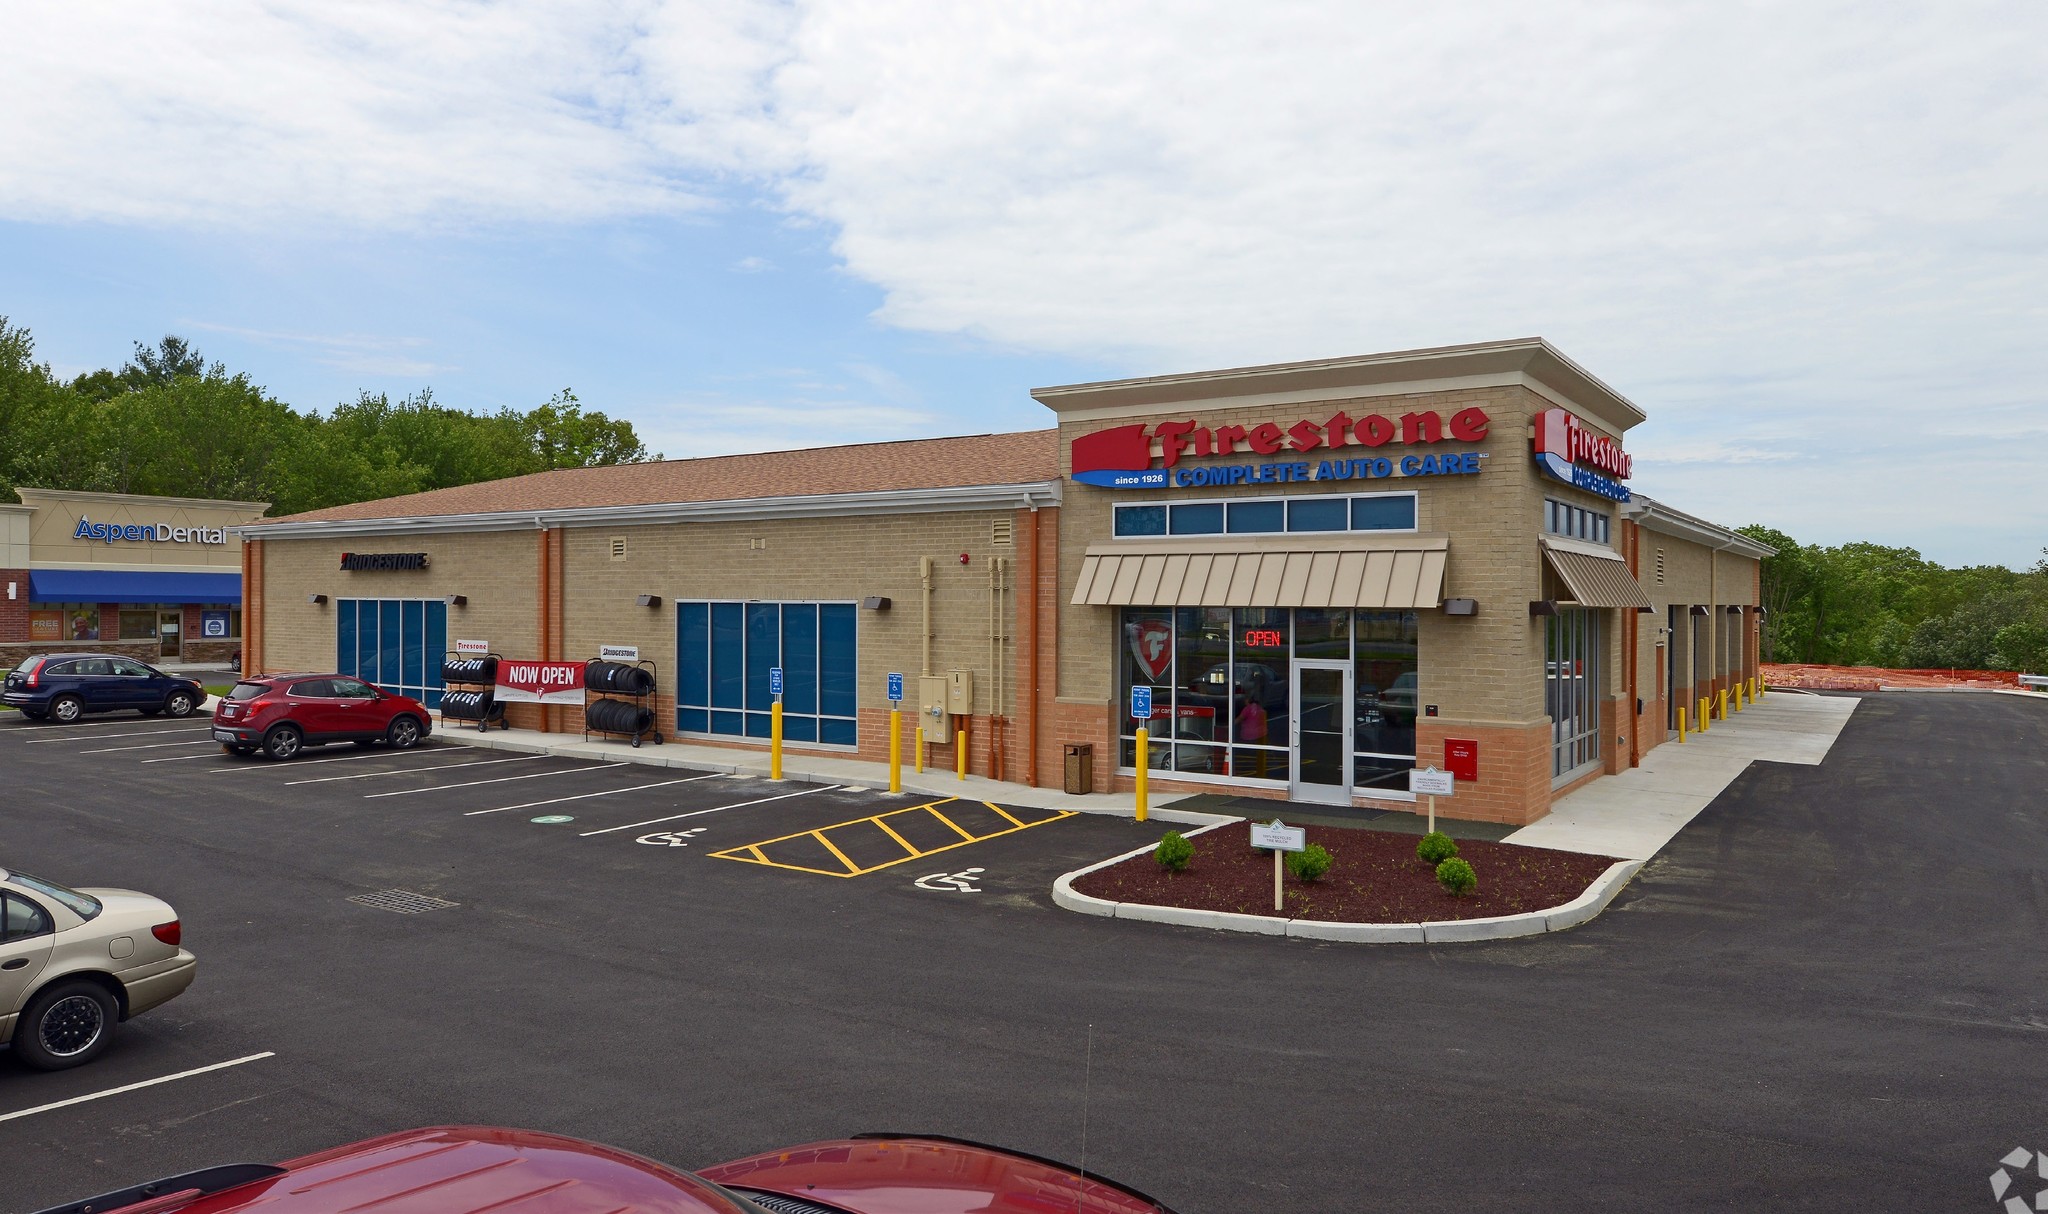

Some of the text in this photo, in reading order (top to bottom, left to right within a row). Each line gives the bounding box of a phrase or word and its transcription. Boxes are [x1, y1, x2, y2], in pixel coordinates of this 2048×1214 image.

[1154, 407, 1490, 468] Firestone
[1568, 414, 1632, 479] Firestone
[1175, 462, 1310, 487] COMPLETE
[1315, 457, 1394, 480] AUTO
[1400, 452, 1480, 476] CARE
[1115, 475, 1163, 485] since 1926
[340, 552, 428, 571] BRIDGESTONE
[458, 642, 487, 650] Firestone
[1246, 631, 1280, 646] OPEN
[603, 648, 636, 657] BRIDGESTONE
[509, 666, 574, 685] NOW OPEN
